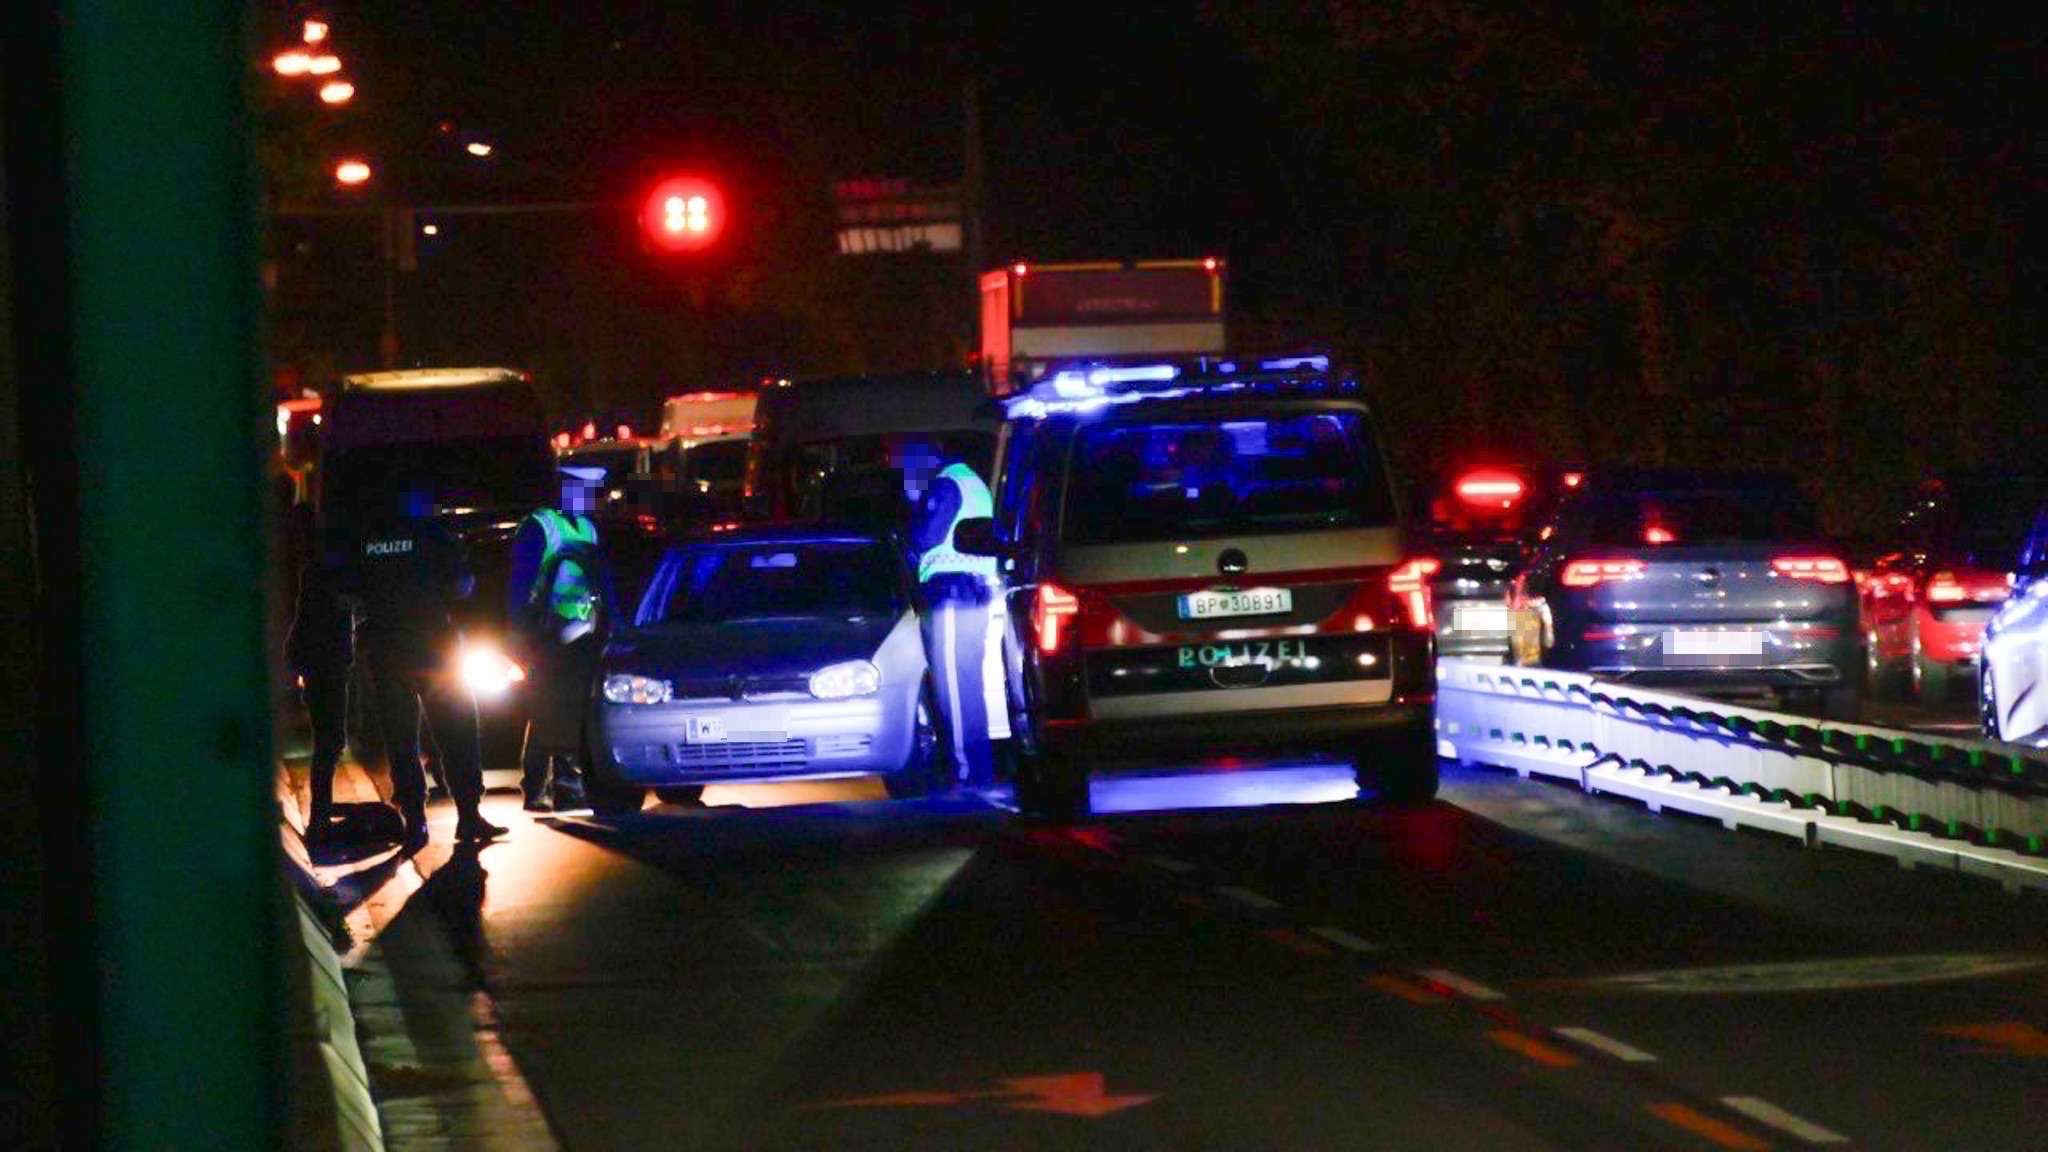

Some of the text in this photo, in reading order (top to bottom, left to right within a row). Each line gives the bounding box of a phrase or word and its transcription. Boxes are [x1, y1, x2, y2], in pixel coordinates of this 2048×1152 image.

[367, 540, 412, 555] POLIZEI
[1196, 597, 1217, 614] BP
[1178, 640, 1307, 668] POLIZEI
